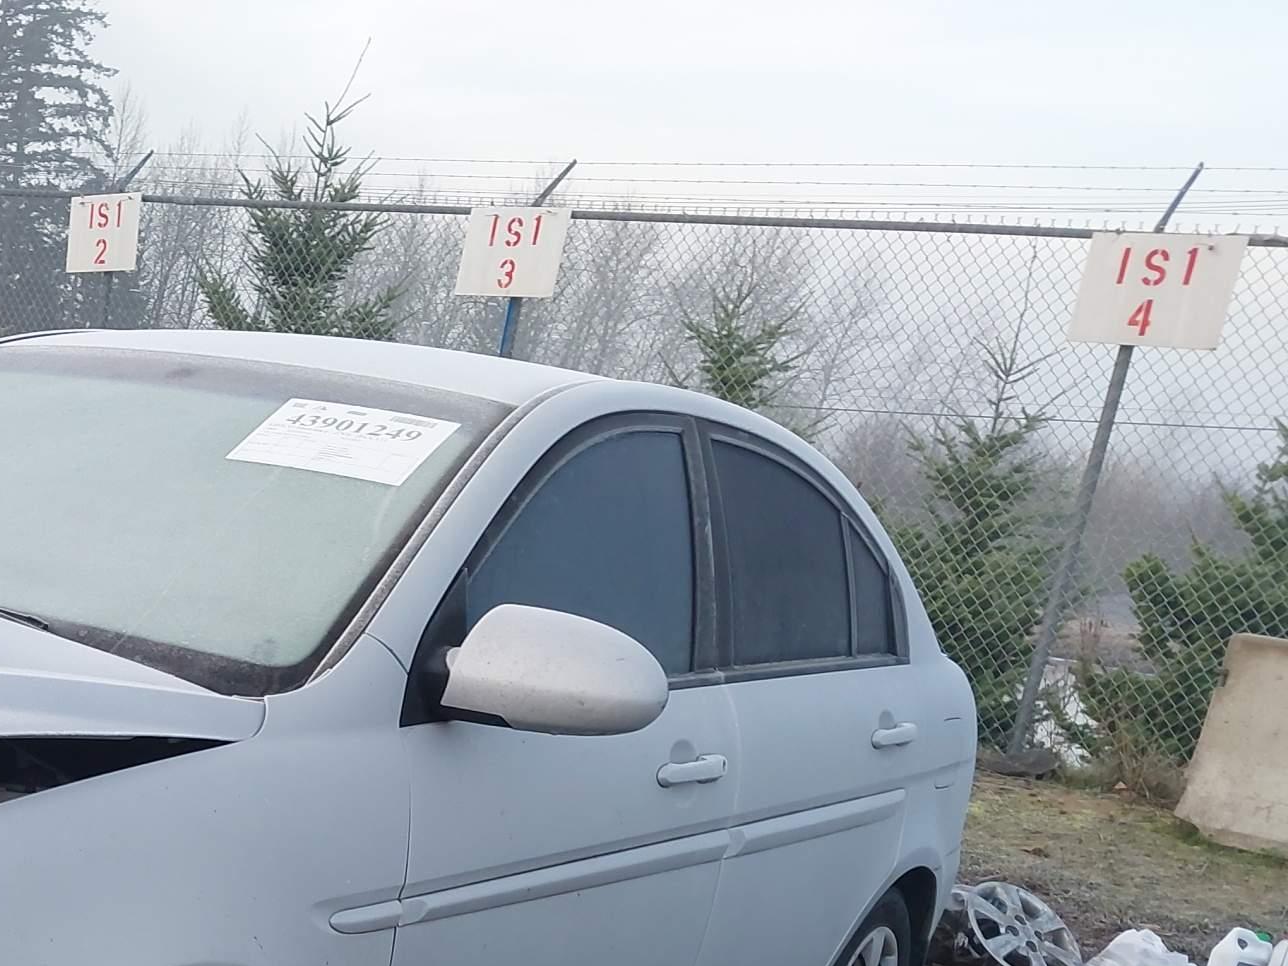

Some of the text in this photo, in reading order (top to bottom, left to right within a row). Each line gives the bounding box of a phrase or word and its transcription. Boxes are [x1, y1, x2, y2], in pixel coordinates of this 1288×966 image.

[94, 239, 107, 265] 2
[497, 259, 516, 289] 3
[1127, 299, 1154, 337] 4
[286, 413, 424, 442] 43901249
